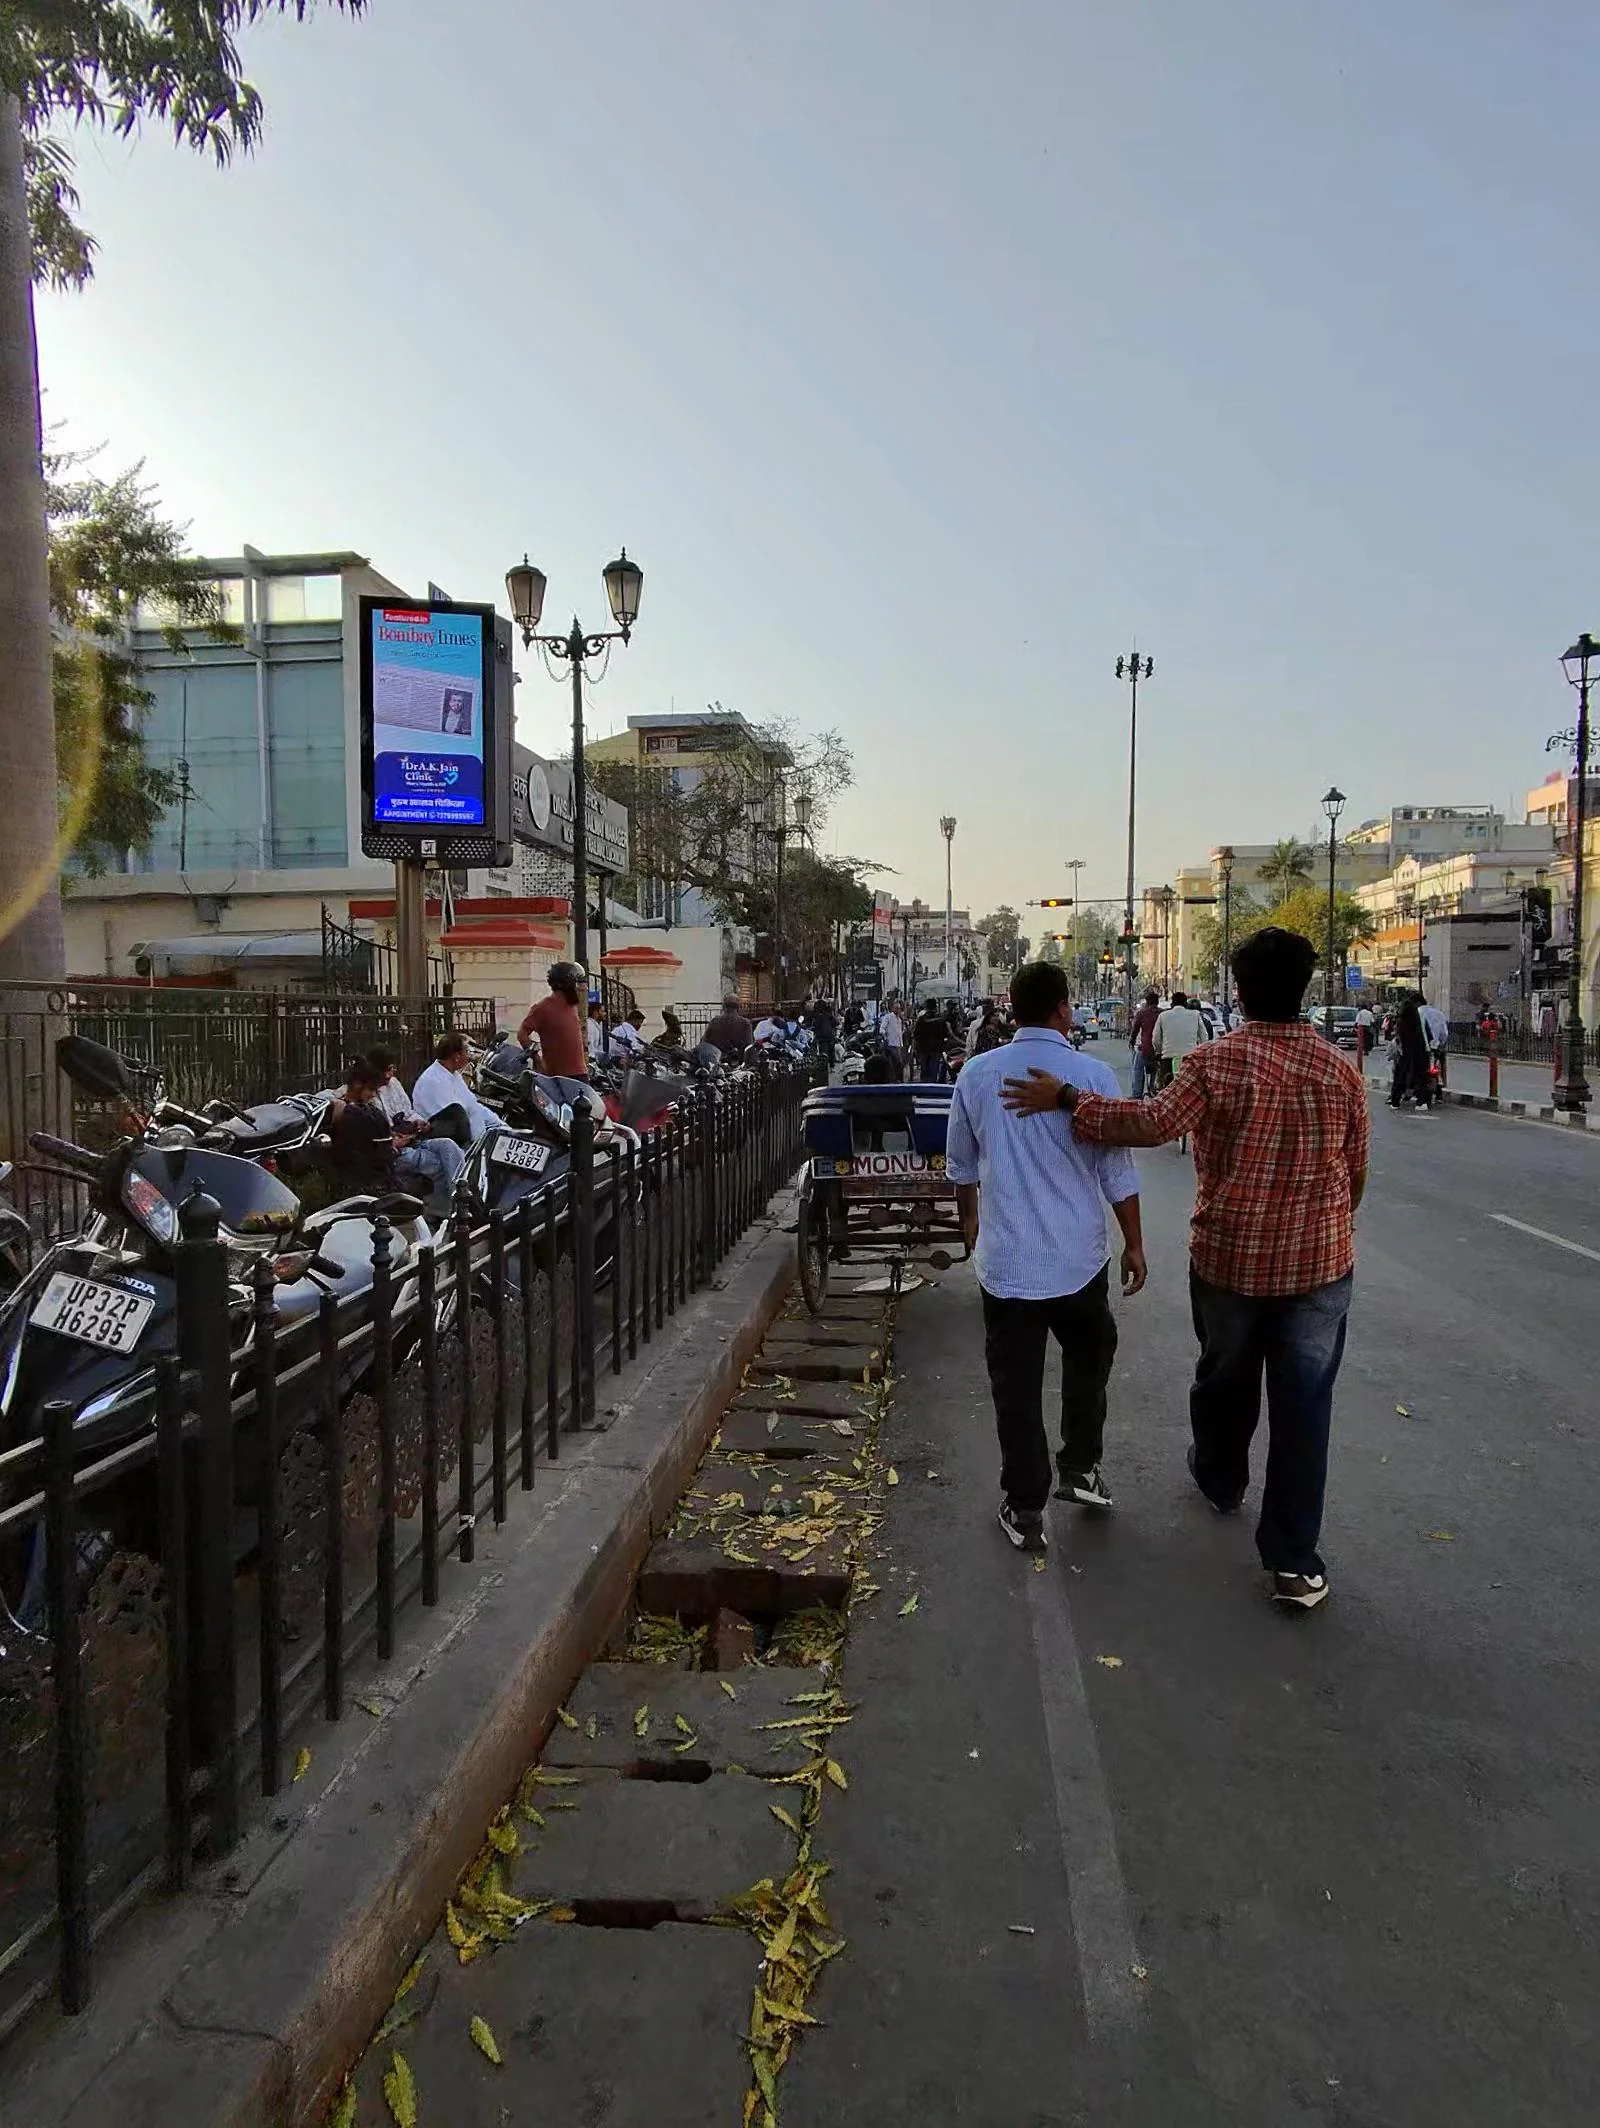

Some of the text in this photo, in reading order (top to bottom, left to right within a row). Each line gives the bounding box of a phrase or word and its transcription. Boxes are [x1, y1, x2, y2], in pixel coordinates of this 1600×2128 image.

[378, 625, 477, 648] Bombay Times
[404, 771, 434, 781] Clinic
[504, 1151, 541, 1169] S2887
[855, 1154, 926, 1175] MONU
[66, 1281, 140, 1321] UP32P
[53, 1305, 127, 1346] H6295
